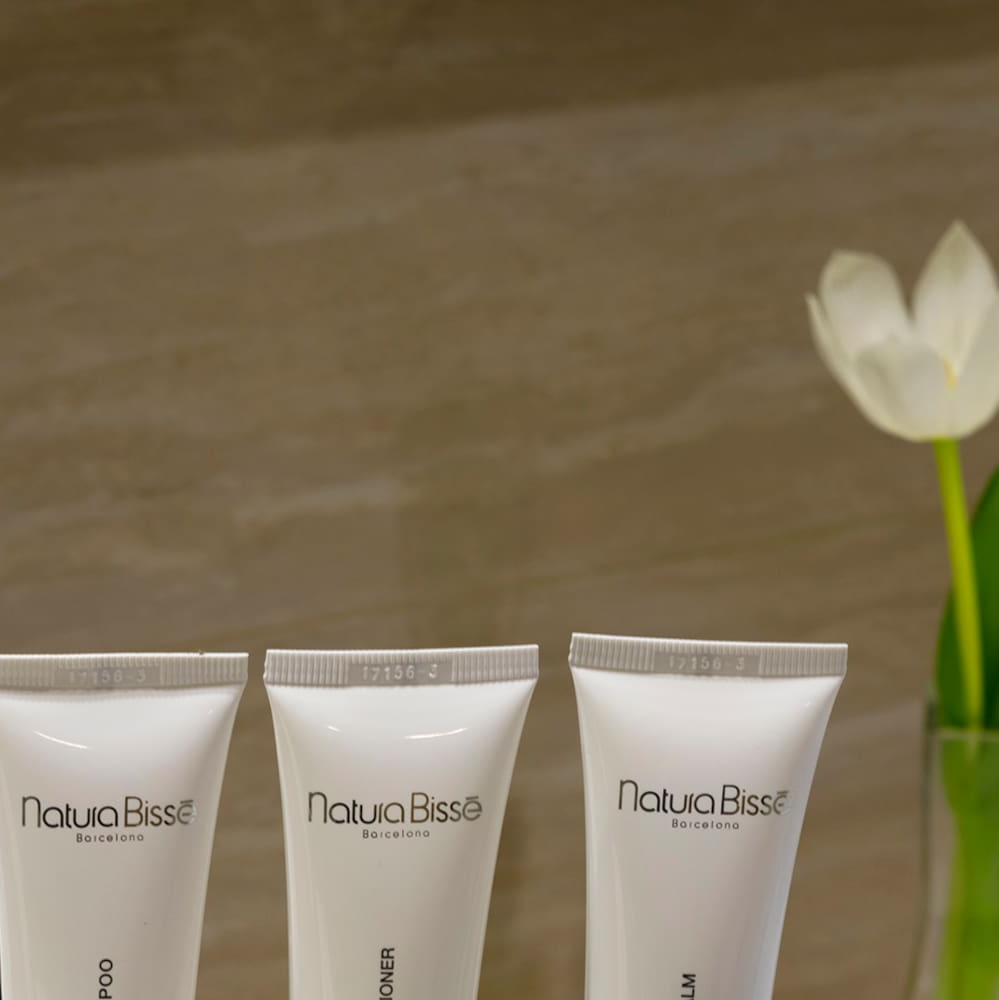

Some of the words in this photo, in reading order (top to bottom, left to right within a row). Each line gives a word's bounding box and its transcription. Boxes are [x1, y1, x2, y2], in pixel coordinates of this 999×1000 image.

[671, 818, 740, 830] Barcelona
[76, 833, 144, 843] Barcelona
[362, 829, 430, 839] Barcelona
